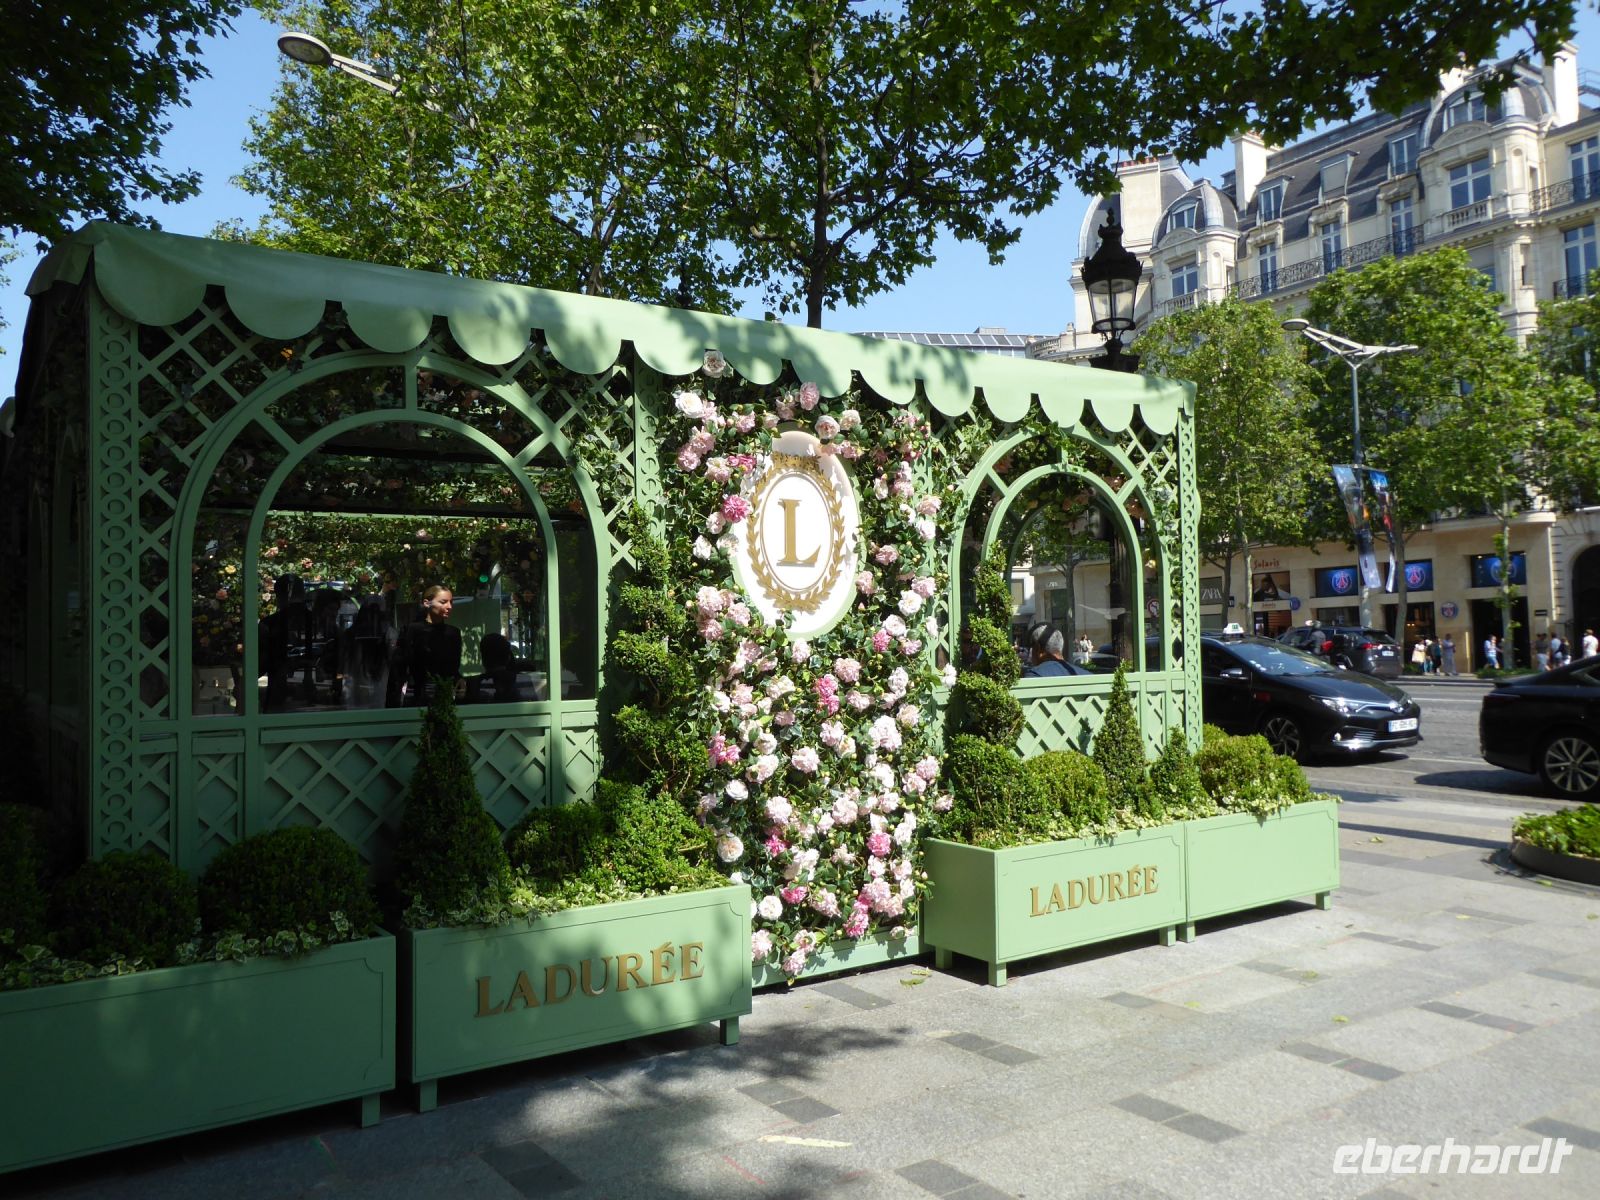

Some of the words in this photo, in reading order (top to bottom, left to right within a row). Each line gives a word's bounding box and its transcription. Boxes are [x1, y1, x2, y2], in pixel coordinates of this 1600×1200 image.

[777, 498, 822, 567] L
[1201, 587, 1222, 600] ZARA
[1030, 864, 1159, 917] LADURÉE
[473, 941, 705, 1018] LADURÉE
